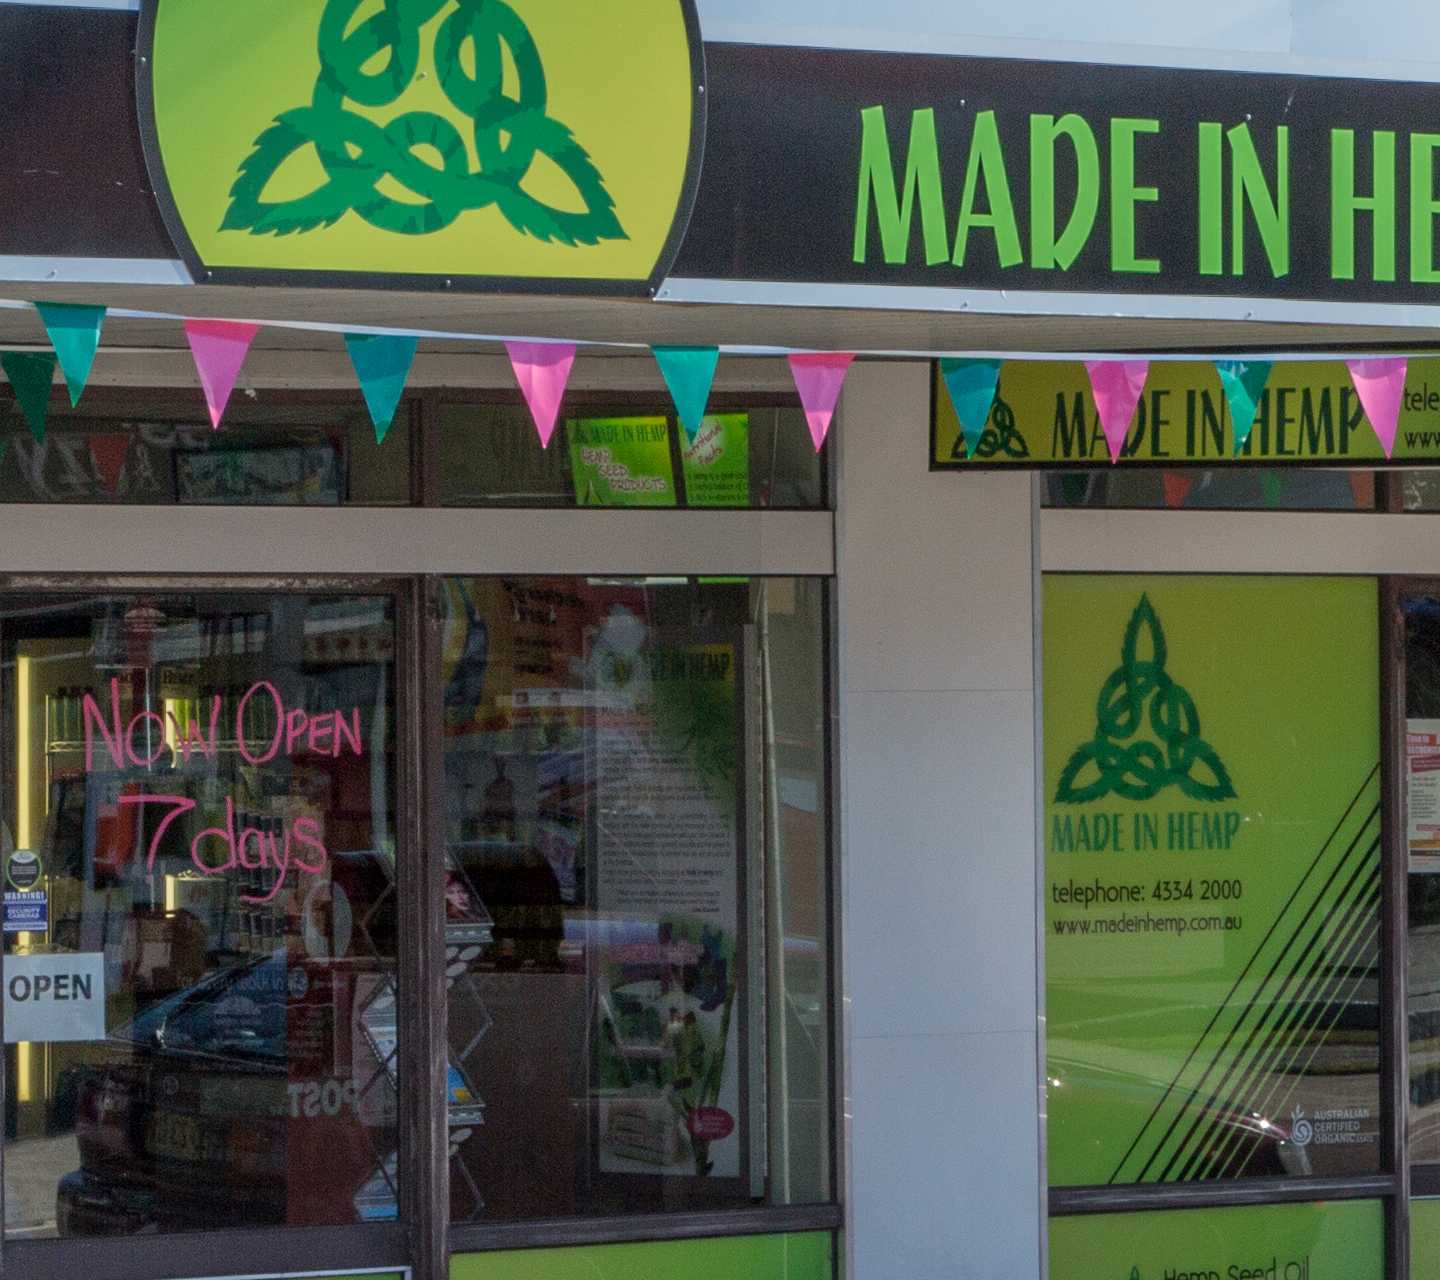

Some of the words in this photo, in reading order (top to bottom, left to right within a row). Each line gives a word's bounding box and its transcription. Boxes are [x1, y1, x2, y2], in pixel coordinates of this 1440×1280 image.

[853, 105, 1162, 273] MADE
[1198, 122, 1290, 279] IN
[1186, 389, 1226, 457] IN
[82, 677, 222, 771] NOW
[236, 680, 363, 765] OPEN
[117, 793, 195, 883] 7
[190, 796, 328, 904] days
[1051, 813, 1125, 853] MADE
[1133, 812, 1159, 852] IN
[1166, 811, 1241, 852] HEMP
[1052, 882, 1146, 909] telephone:
[1151, 881, 1194, 901] 4334
[1200, 880, 1242, 901] 2000
[1053, 912, 1243, 937] www.madeinhemp.com.au
[9, 974, 92, 1002] OPEN
[1314, 1109, 1370, 1120] AUSTRALIAN
[1314, 1121, 1360, 1132] CERTIFIED
